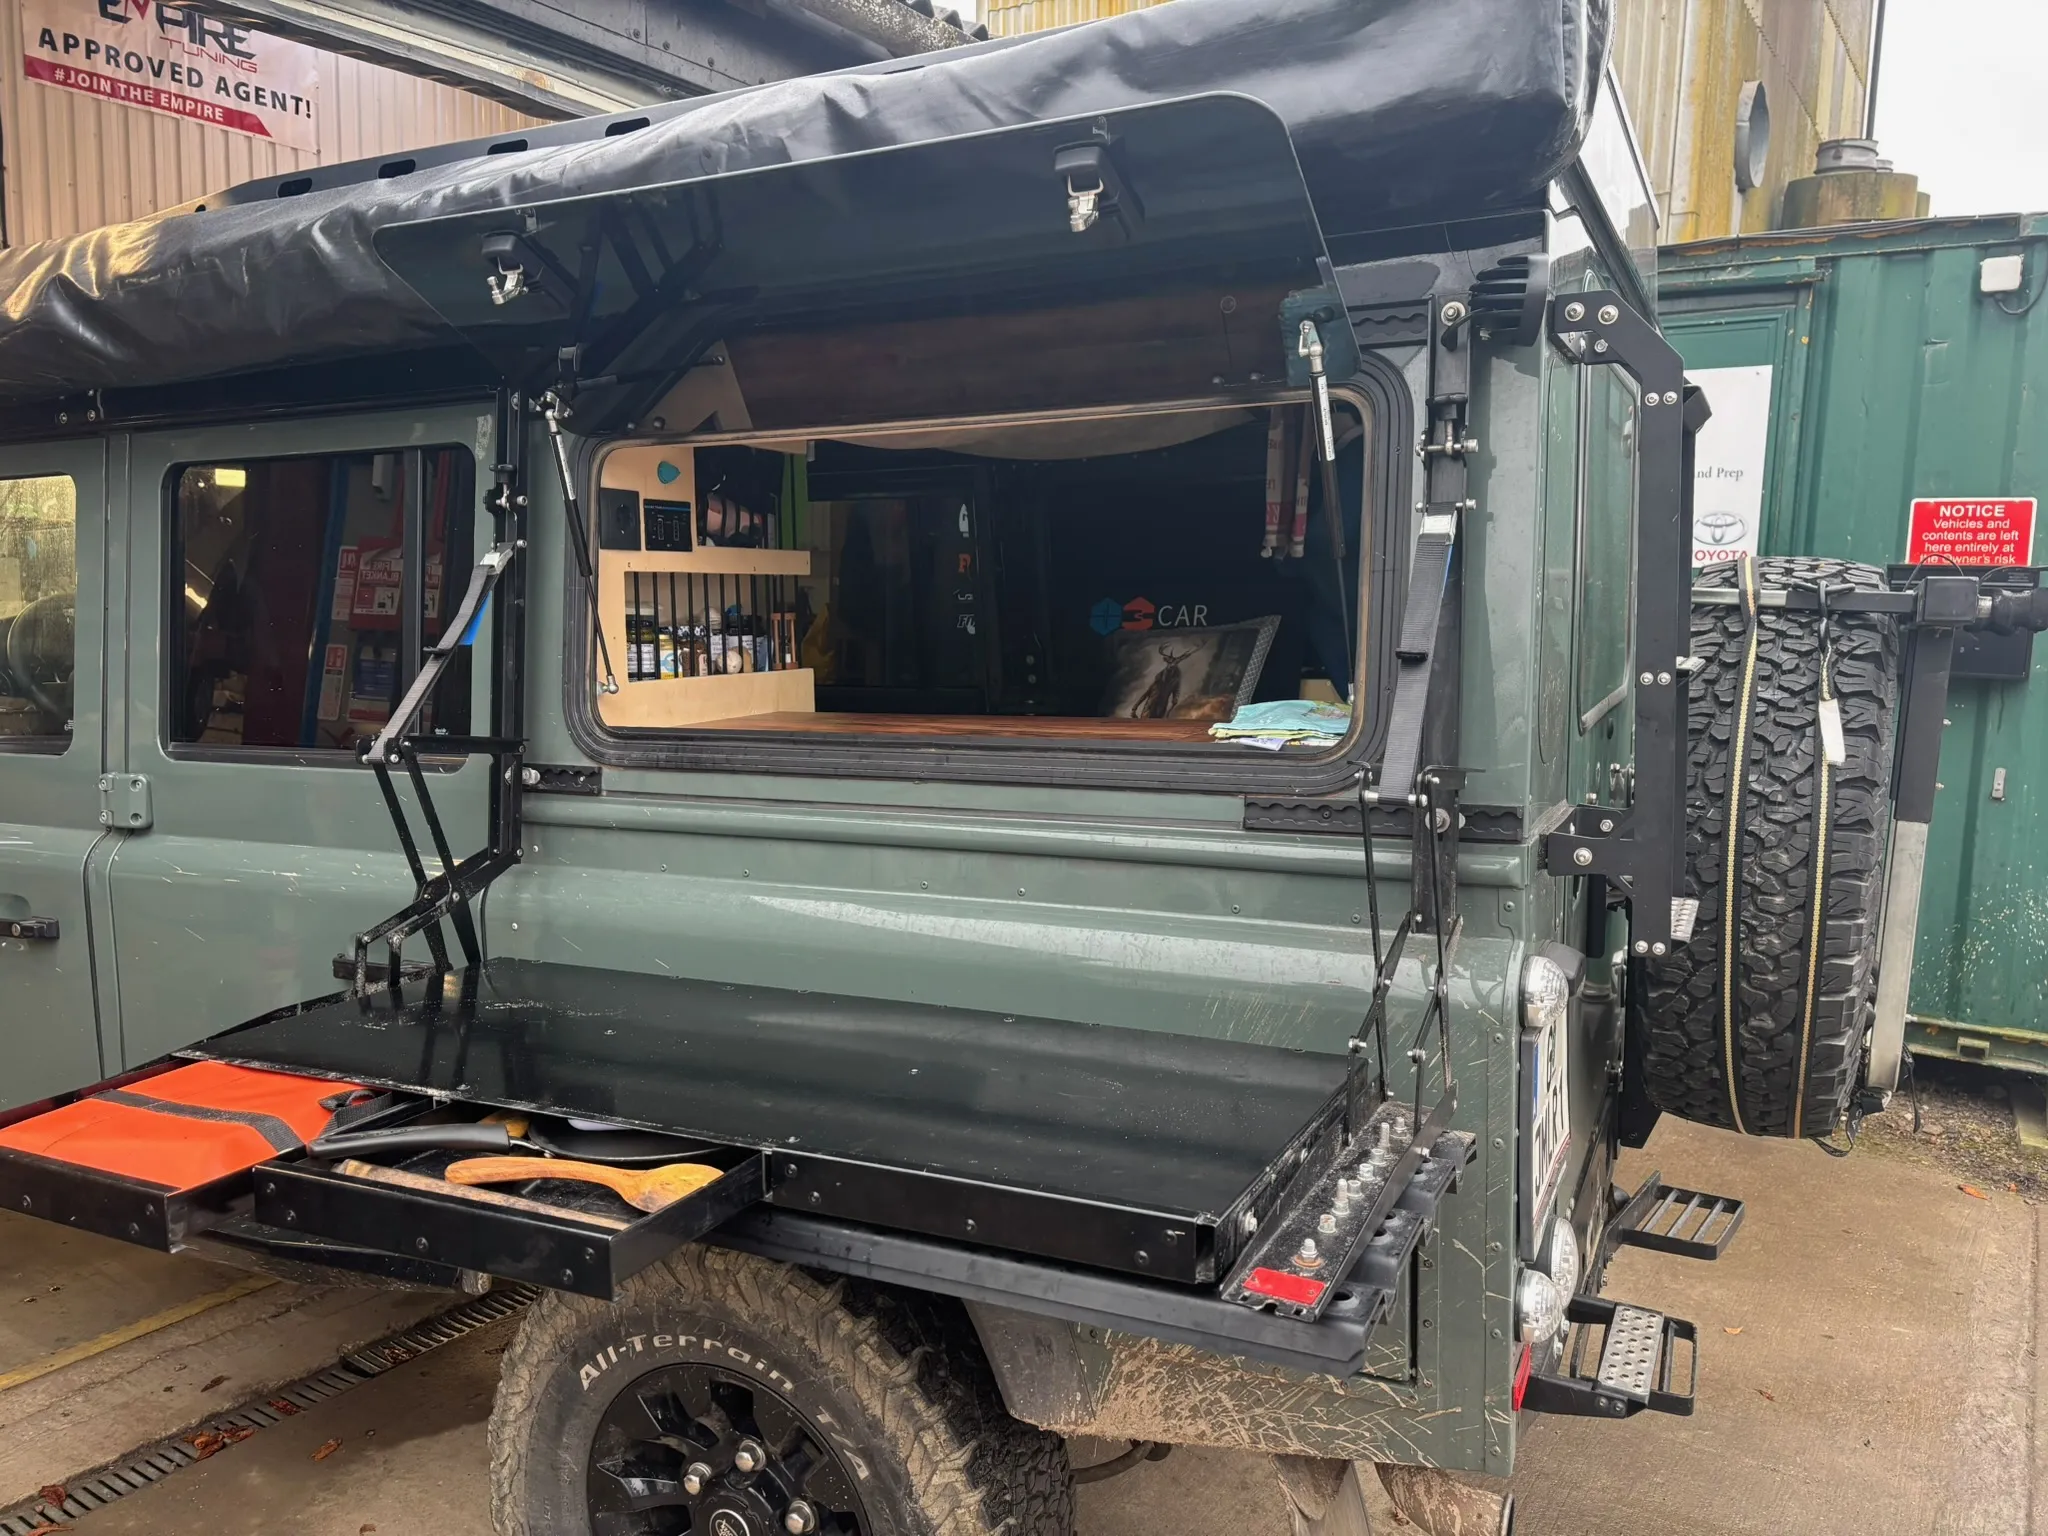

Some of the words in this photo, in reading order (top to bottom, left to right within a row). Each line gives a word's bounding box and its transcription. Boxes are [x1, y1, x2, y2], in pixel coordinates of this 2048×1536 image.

[159, 36, 258, 74] TUNING
[38, 27, 204, 89] APPROVED
[215, 76, 312, 119] AGENT!
[54, 68, 112, 95] #JOIN
[119, 83, 154, 104] THE
[160, 93, 224, 123] EMPIRE
[1695, 466, 1712, 479] nd
[1716, 467, 1744, 481] Prep
[1939, 504, 2006, 518] NOTICE
[1933, 518, 1984, 529] Vehicles
[1987, 518, 2010, 529] and
[1922, 531, 1973, 541] contents
[1977, 532, 1997, 541] are
[2000, 530, 2019, 541] left
[1694, 549, 1748, 561] OYOTA
[1924, 542, 1952, 552] here
[1954, 542, 1999, 555] entirely
[2002, 542, 2015, 552] at
[1994, 553, 2016, 564] risk
[1158, 604, 1208, 627] CAR
[579, 1334, 794, 1392] All-Terrain
[816, 1405, 870, 1480] T/A
